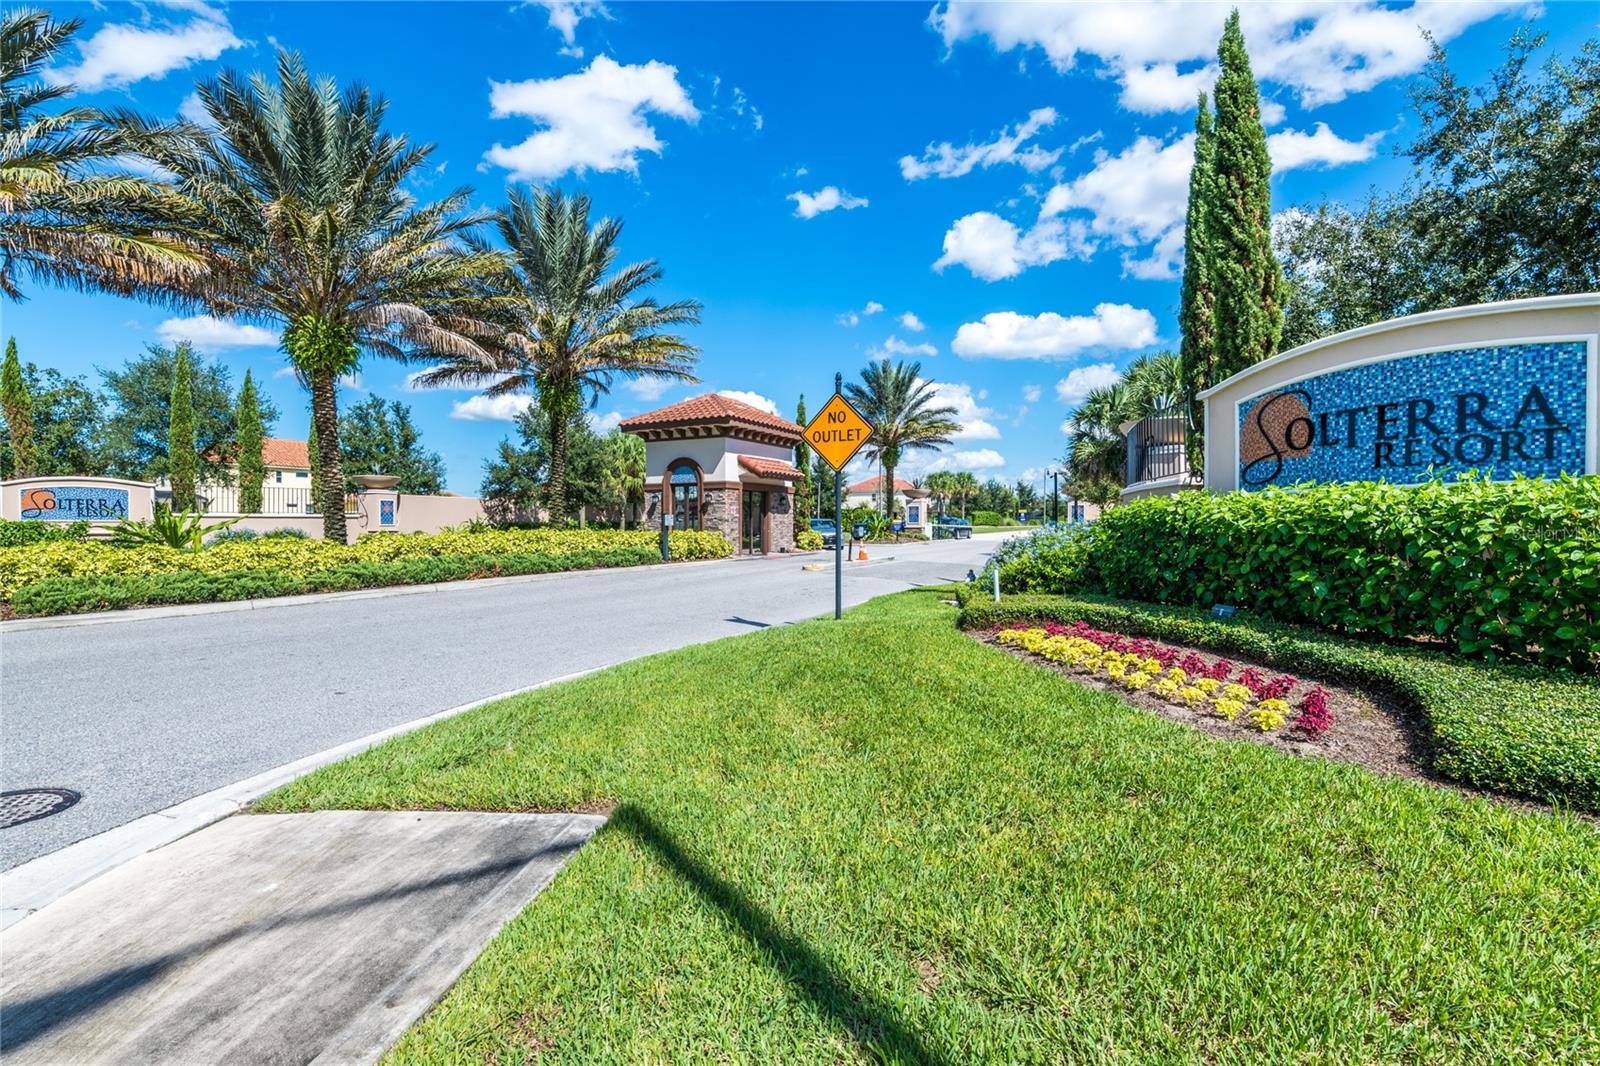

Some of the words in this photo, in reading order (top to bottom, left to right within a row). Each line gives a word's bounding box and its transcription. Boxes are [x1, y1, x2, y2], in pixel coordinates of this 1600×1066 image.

[828, 411, 846, 423] NO
[812, 429, 861, 443] OUTLET
[1242, 384, 1568, 485] SOLTERRA
[1375, 427, 1568, 468] RESORT
[22, 490, 125, 518] SOLTERRA
